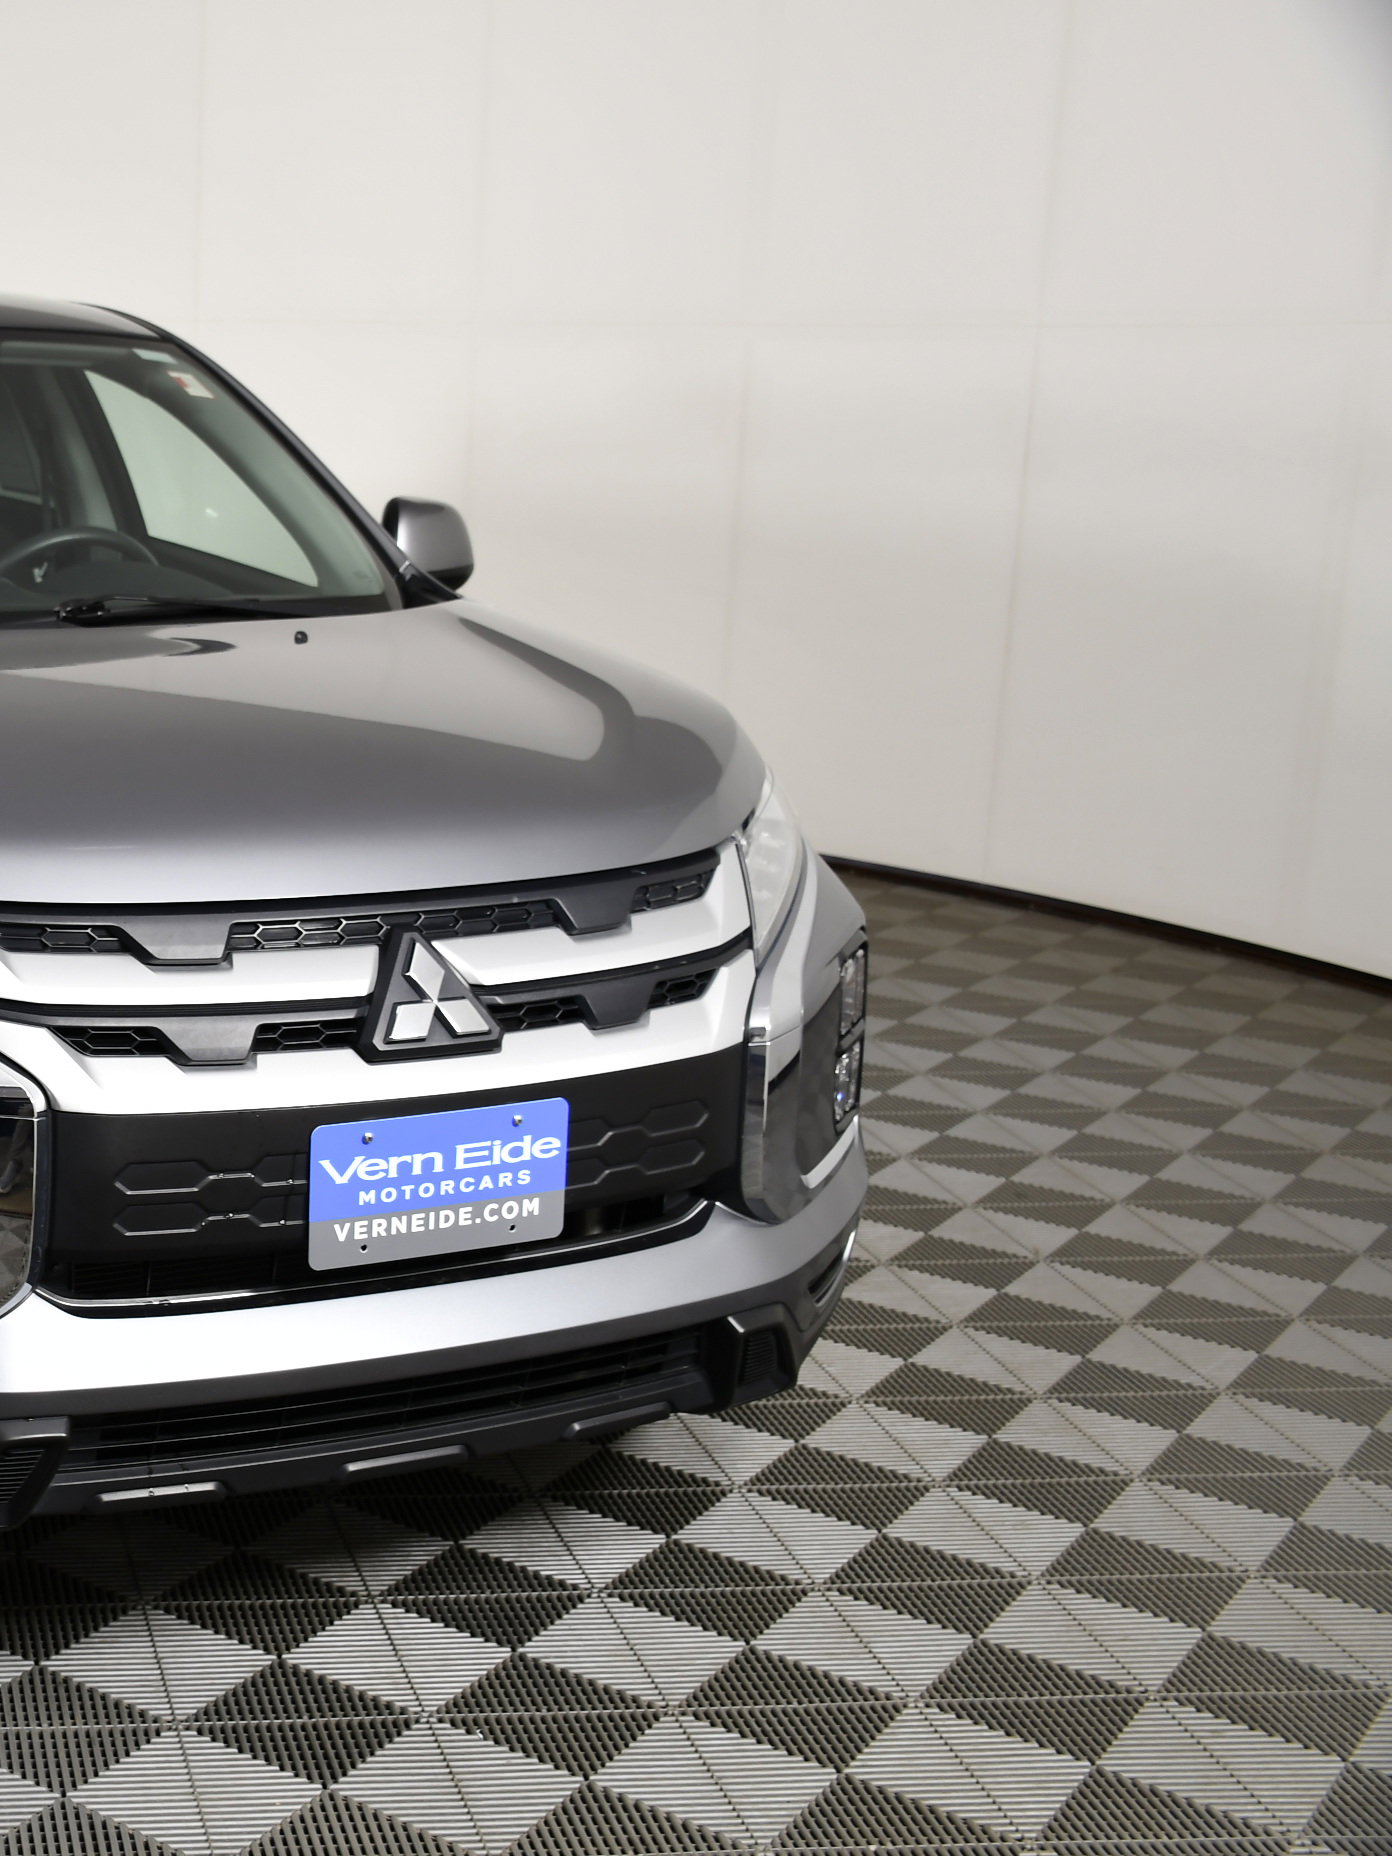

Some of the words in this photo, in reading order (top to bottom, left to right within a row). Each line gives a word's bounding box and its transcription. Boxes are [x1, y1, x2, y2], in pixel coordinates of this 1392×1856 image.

[319, 1151, 444, 1184] Vern
[454, 1135, 561, 1170] Eide
[358, 1169, 531, 1205] MOTORCARS
[334, 1197, 540, 1242] VERNEIDE.COM
